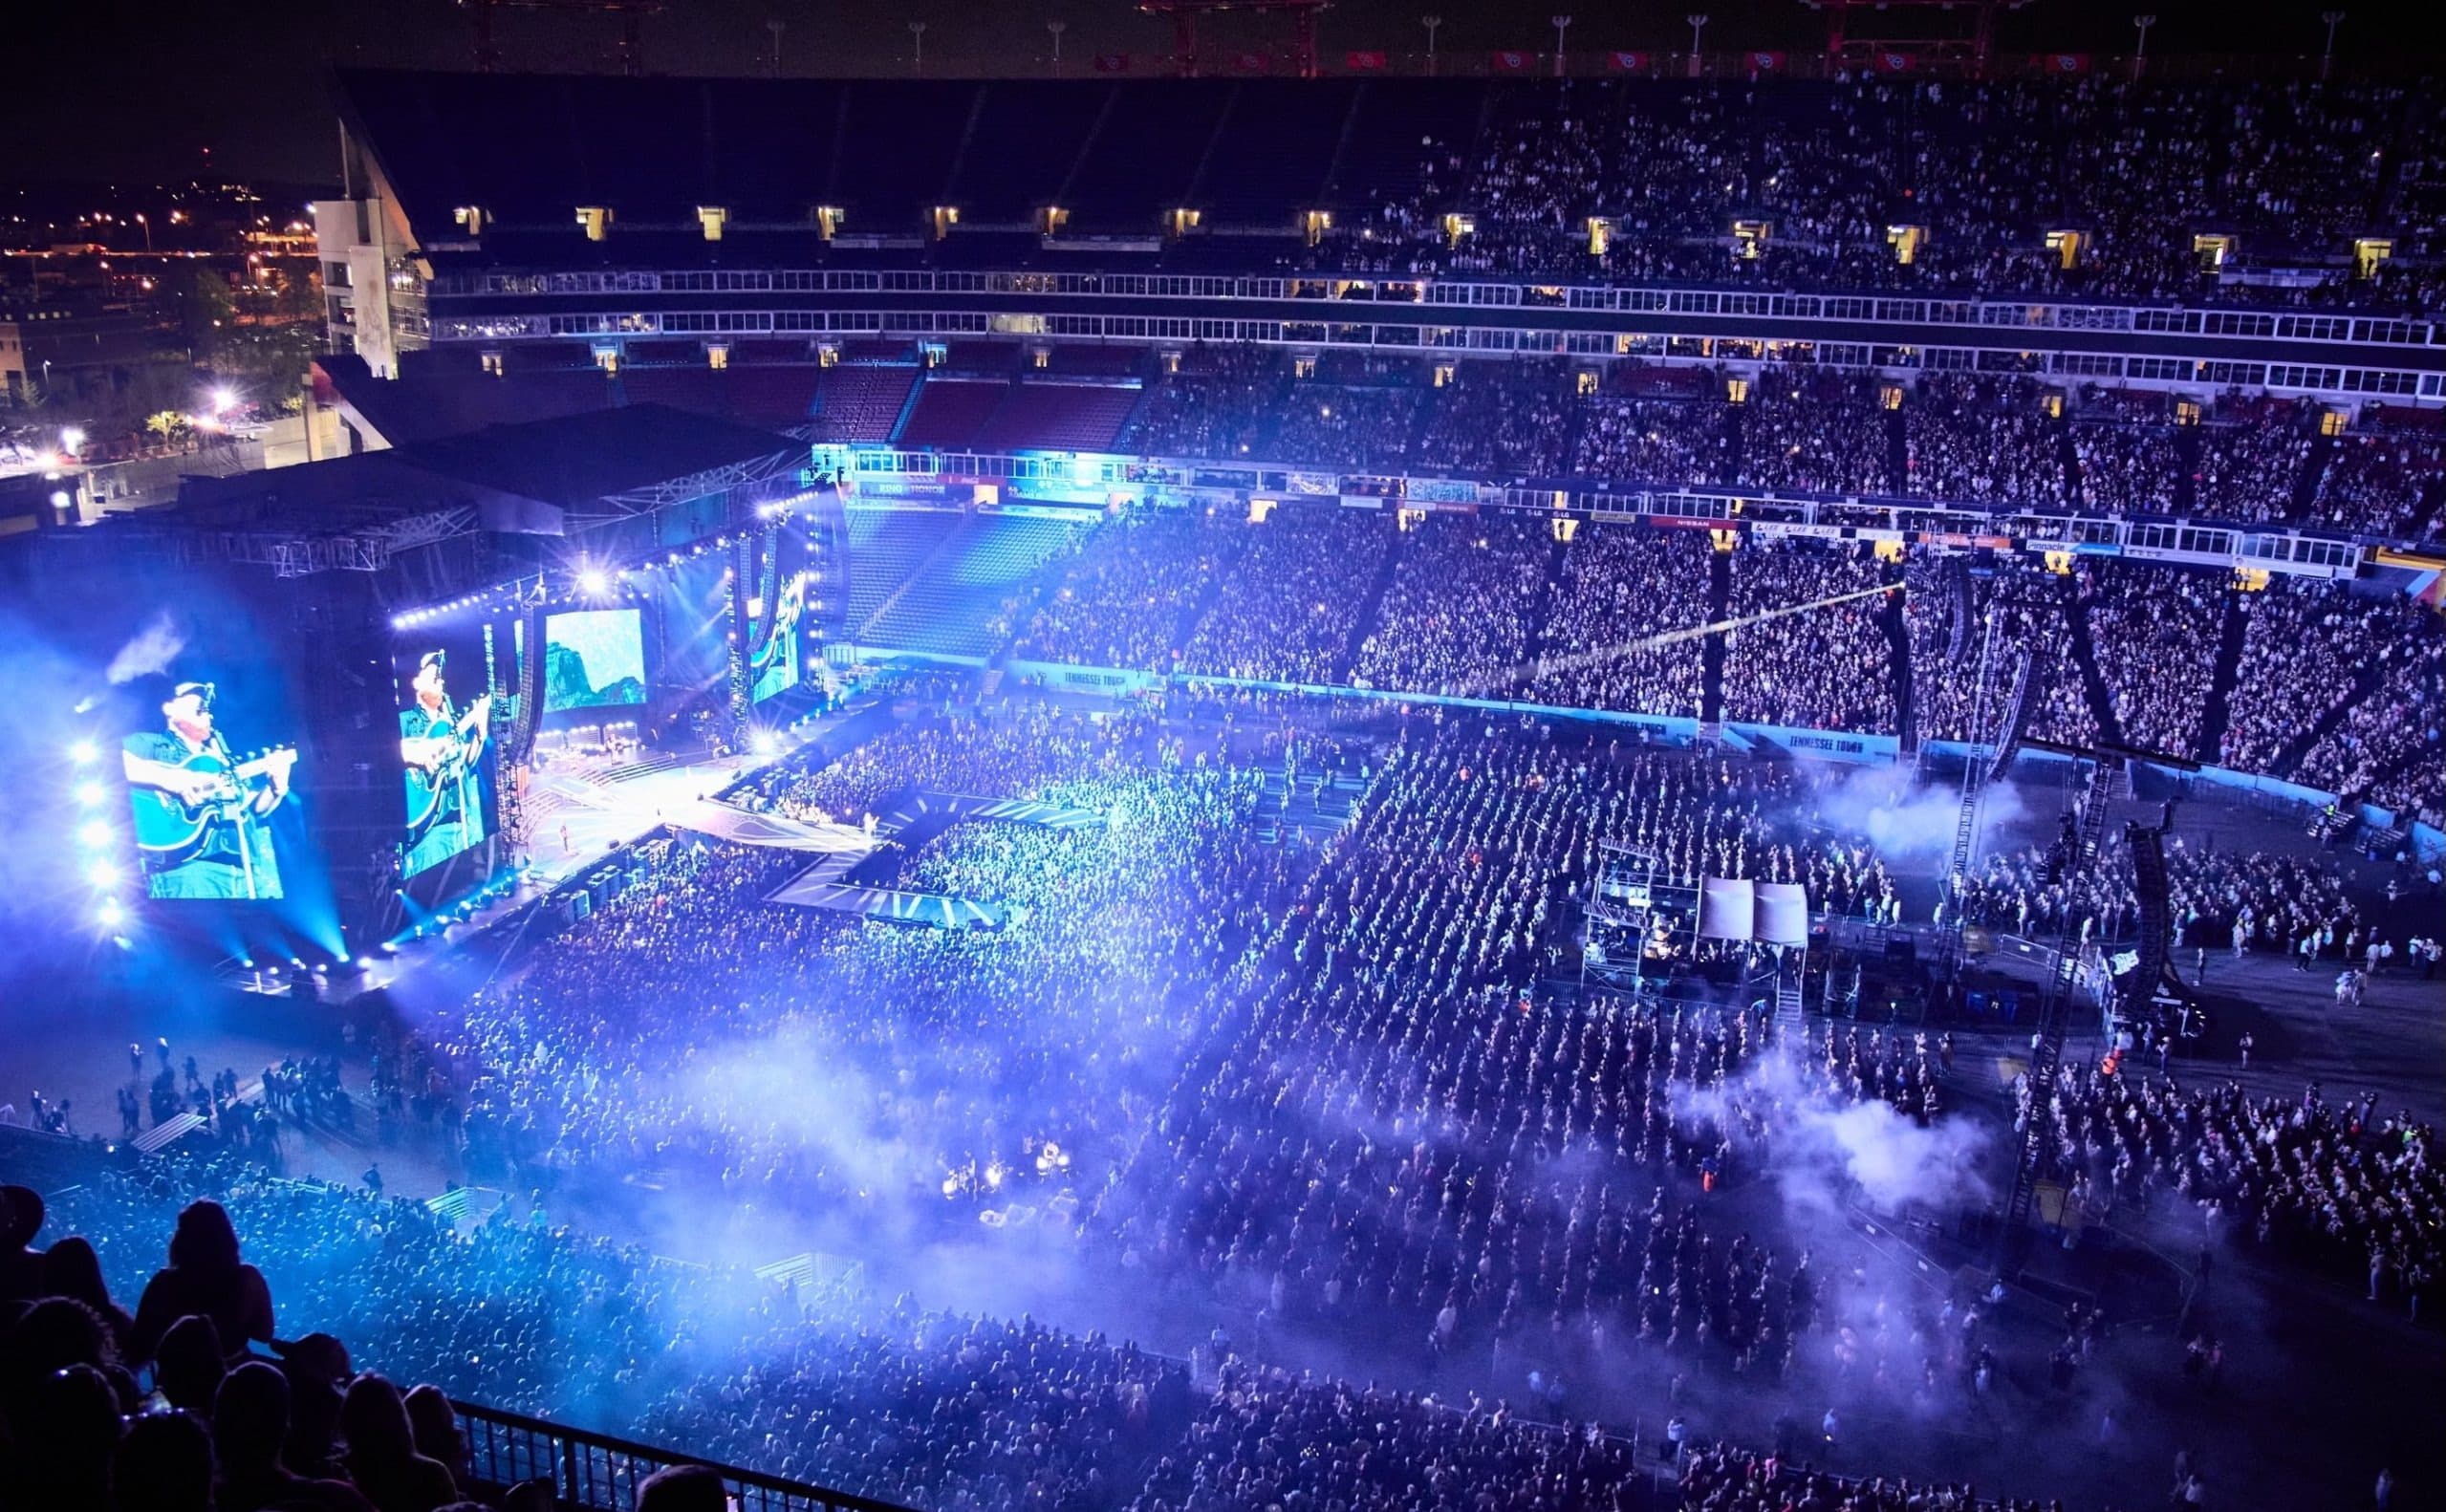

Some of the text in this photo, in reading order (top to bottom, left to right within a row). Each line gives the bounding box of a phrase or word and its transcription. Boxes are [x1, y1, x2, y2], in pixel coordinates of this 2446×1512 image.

[2027, 541, 2065, 551] Pinnacle
[1065, 672, 1100, 685] TENNESSEE
[1790, 736, 1833, 750] TENNESSEE
